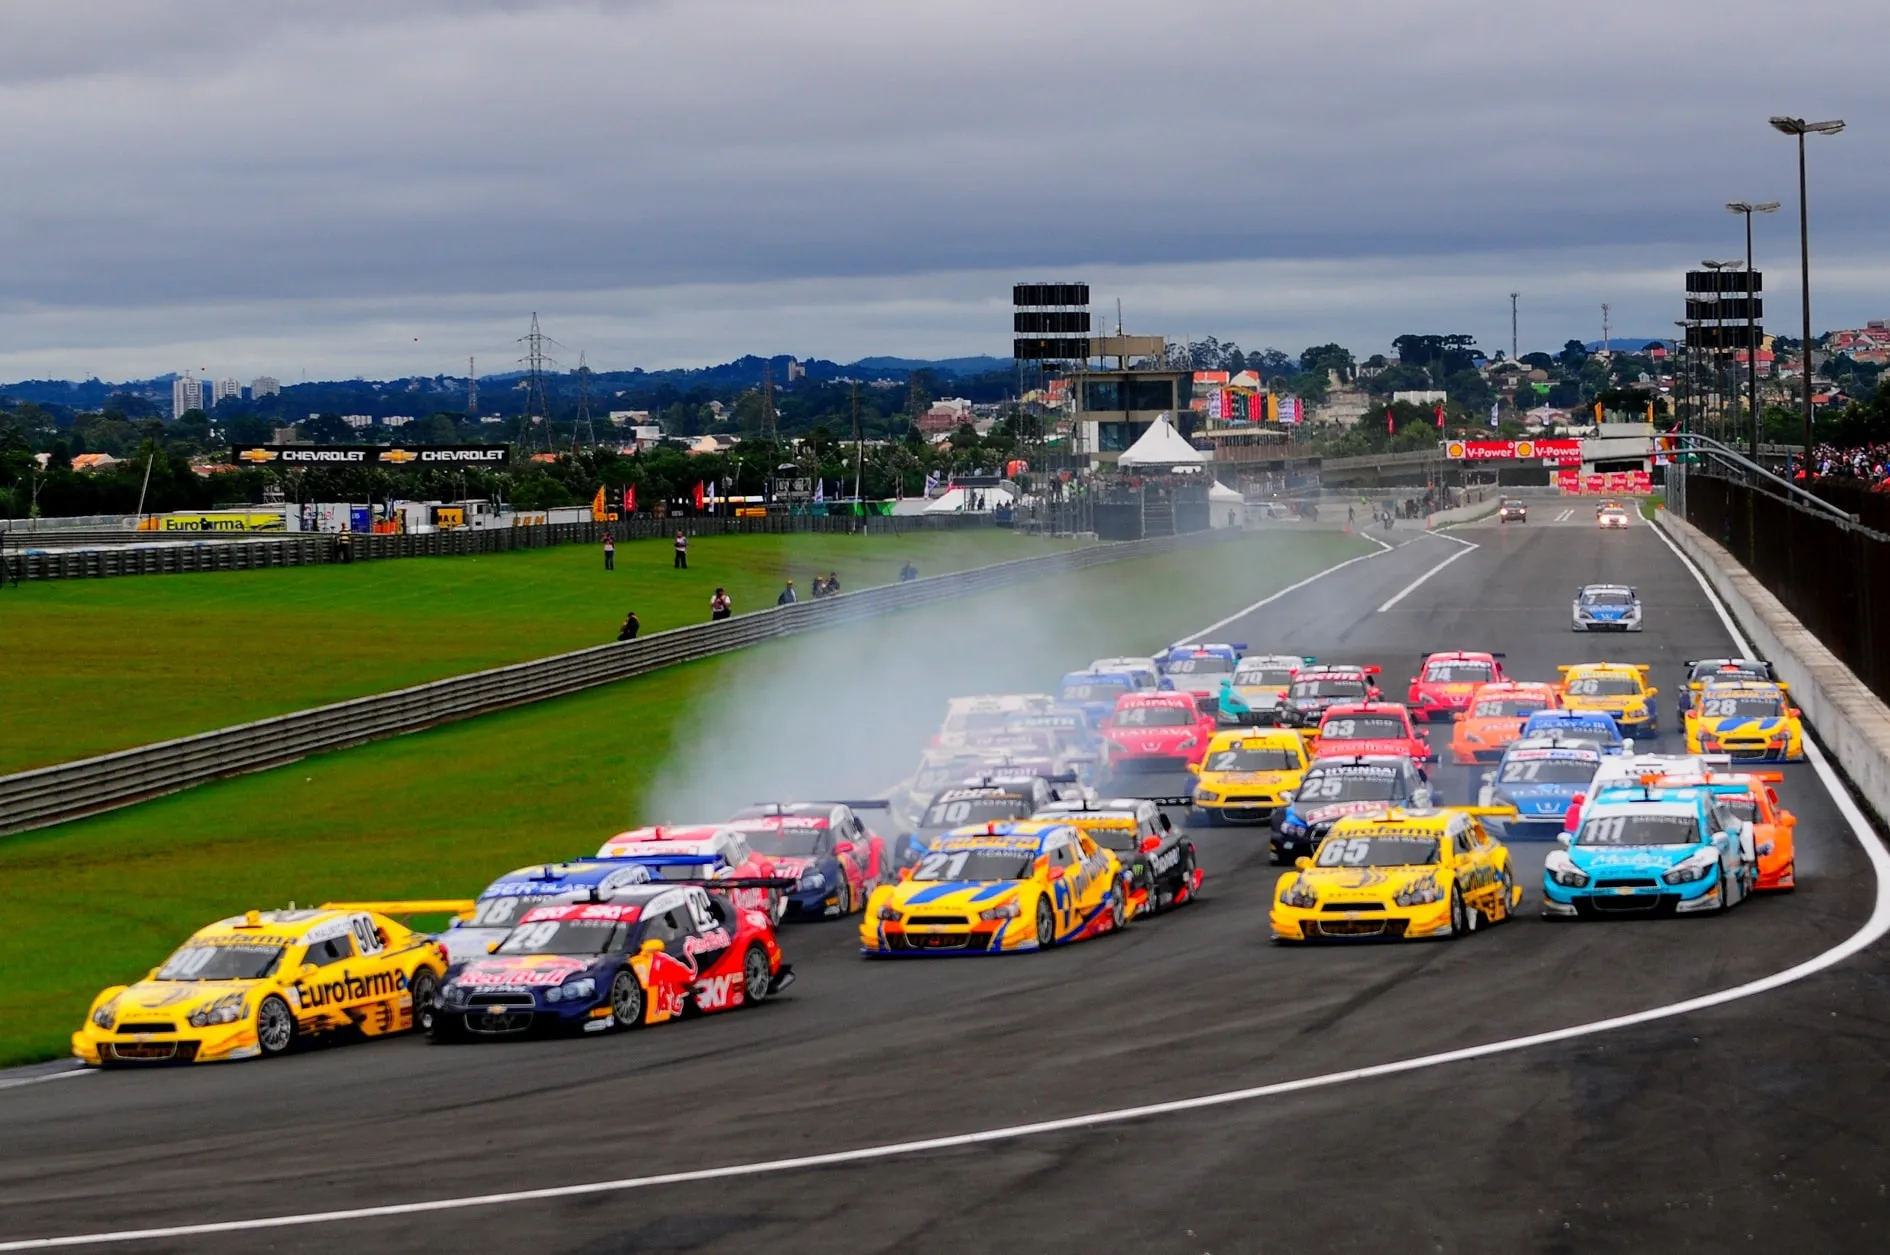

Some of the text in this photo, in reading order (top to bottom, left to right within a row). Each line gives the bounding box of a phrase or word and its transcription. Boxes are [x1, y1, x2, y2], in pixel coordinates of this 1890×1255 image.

[282, 449, 365, 463] CHEVROLET
[421, 450, 504, 462] CHEVROLET
[1466, 448, 1512, 458] V-Power
[1535, 447, 1580, 457] V-Power
[1239, 671, 1263, 685] 70
[1295, 672, 1362, 682] LOCTITE
[1428, 667, 1451, 682] 74
[1064, 686, 1092, 699] 20
[1294, 681, 1321, 697] 11
[1124, 699, 1185, 709] ITAIPAVA
[1703, 699, 1737, 716] 28
[1118, 709, 1146, 724] 14
[1111, 728, 1192, 739] ITAIPAVA
[1322, 719, 1355, 738] 63
[1214, 751, 1237, 770] 2
[1325, 767, 1397, 778] HYUNDAI
[1502, 761, 1541, 782] 27
[1302, 778, 1342, 799] 25
[930, 802, 971, 824] 10
[1585, 817, 1626, 843] 111
[1317, 839, 1372, 865] 65
[914, 851, 970, 880] 21
[476, 897, 519, 925] 18
[353, 916, 380, 953] 90
[499, 921, 561, 950] 29
[158, 946, 218, 979] 90
[457, 967, 569, 987] Red Bull
[295, 967, 408, 1010] Eurofarma
[695, 974, 733, 1009] SKY
